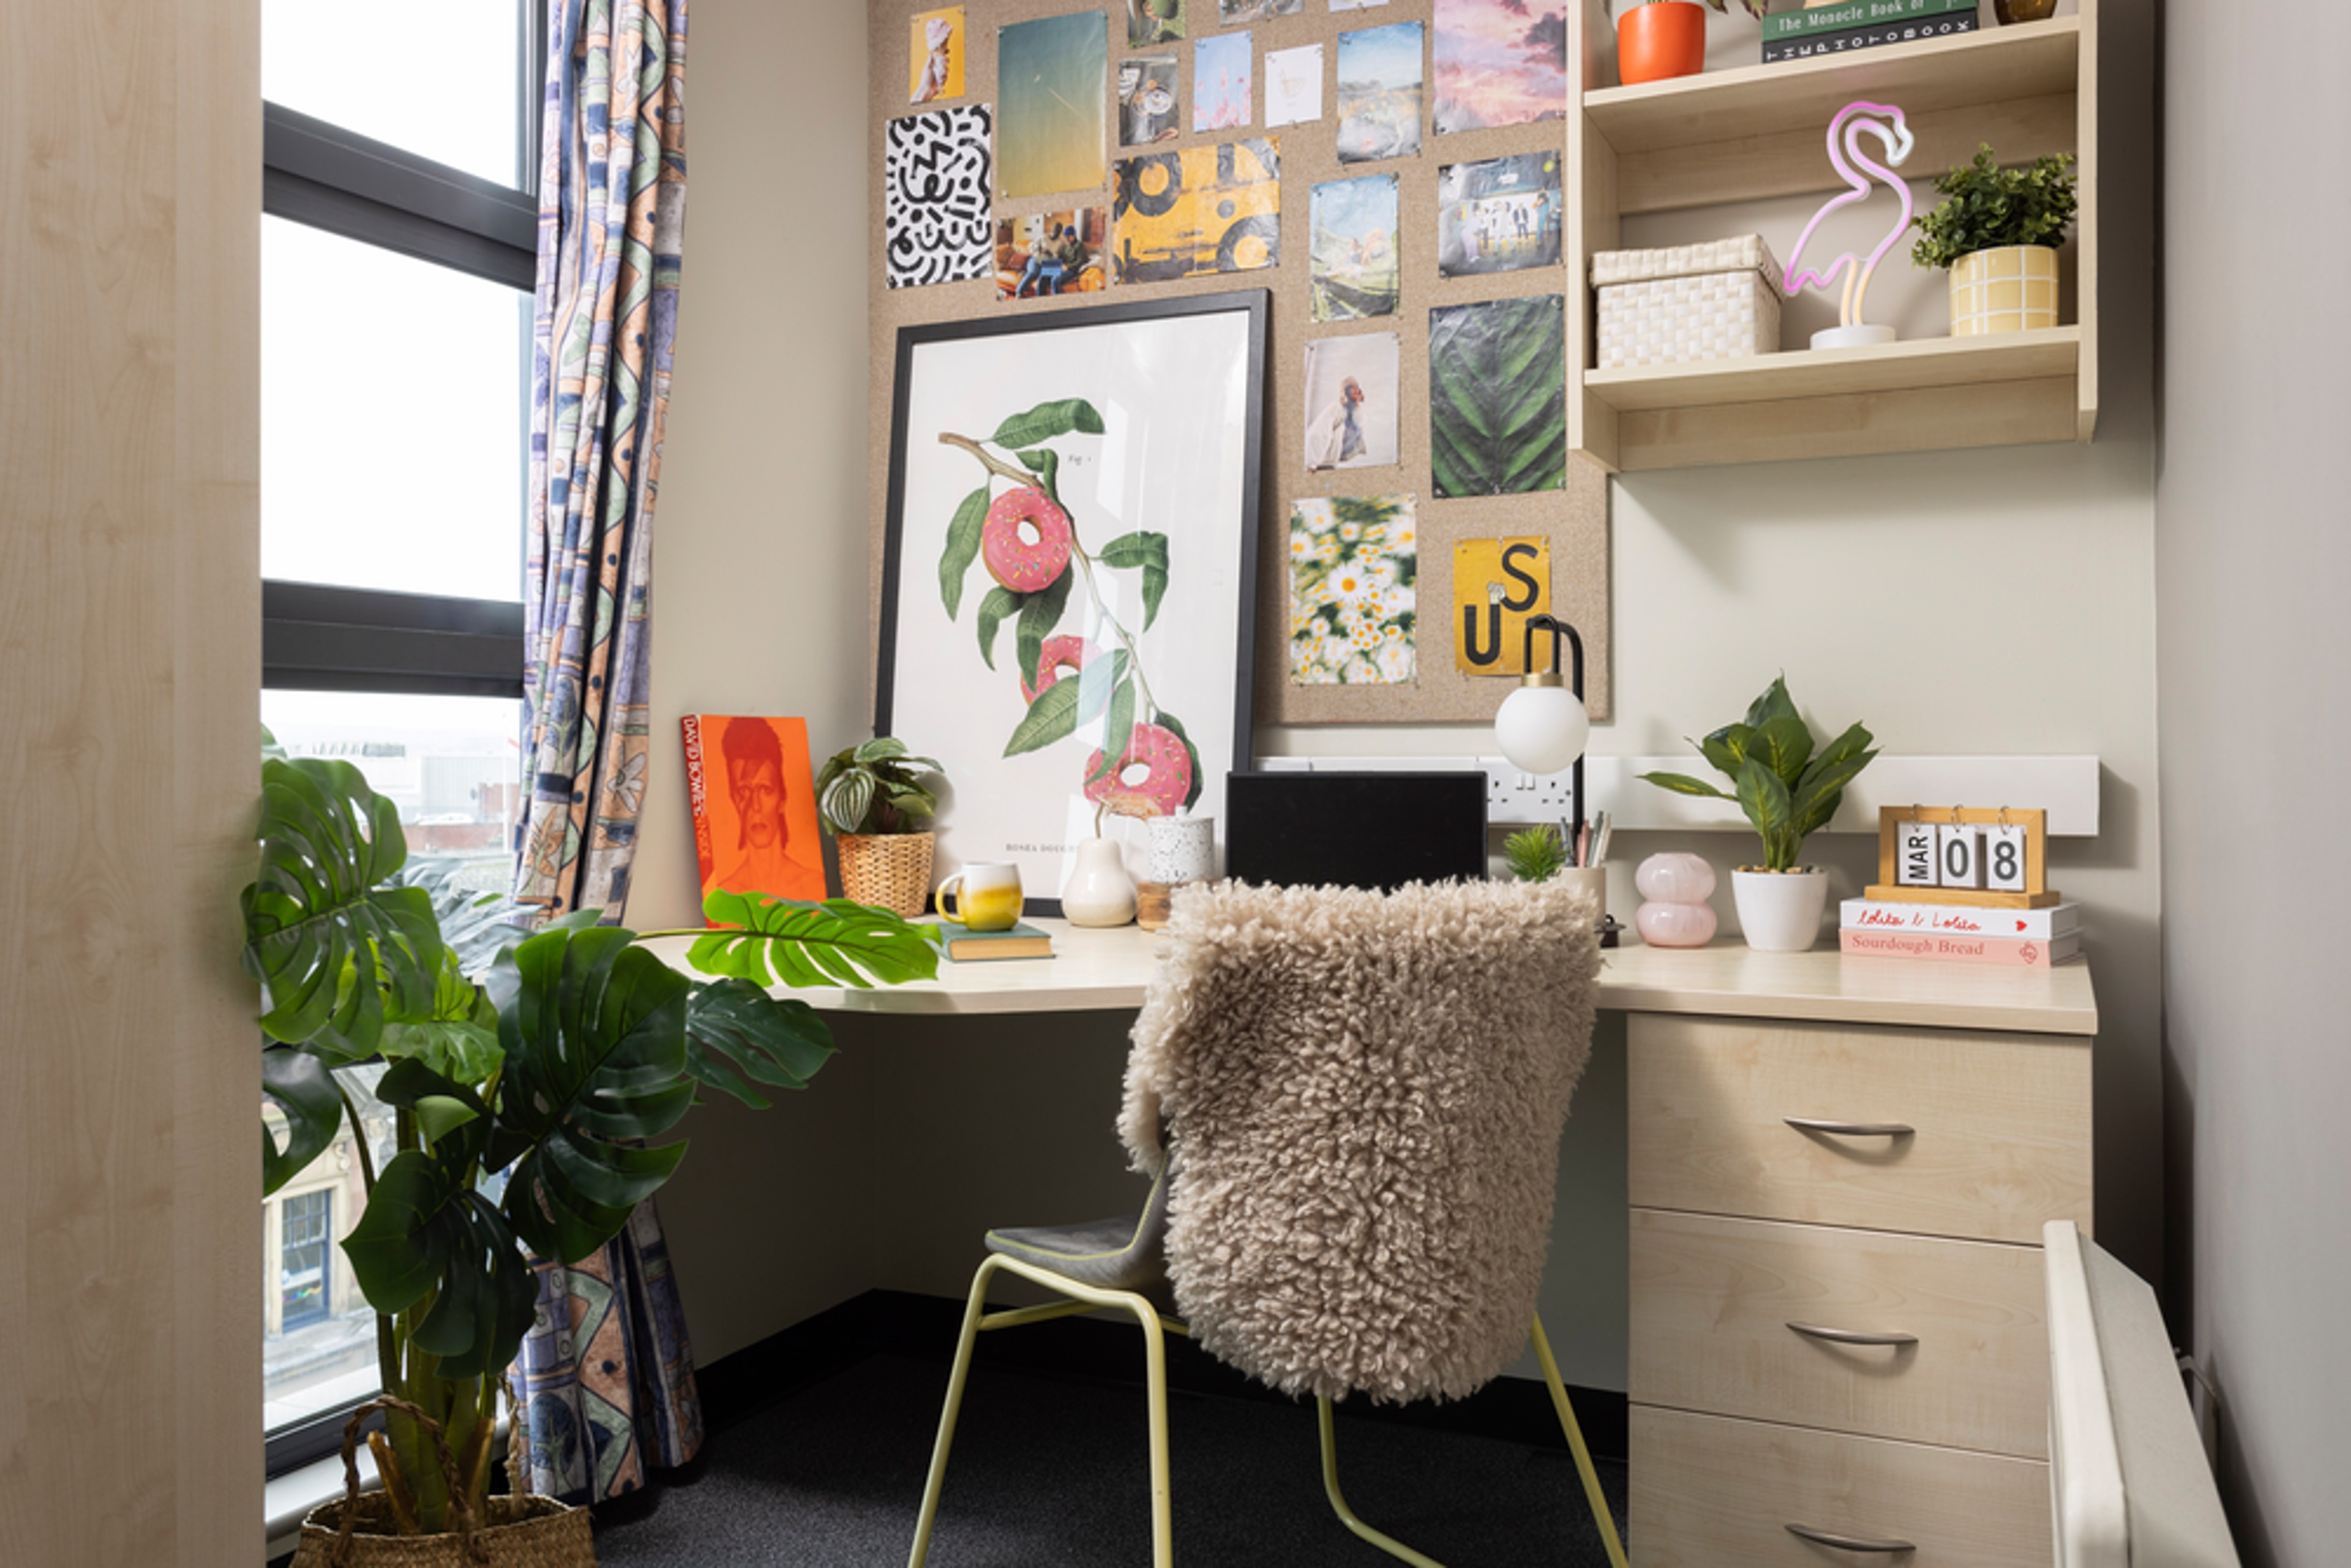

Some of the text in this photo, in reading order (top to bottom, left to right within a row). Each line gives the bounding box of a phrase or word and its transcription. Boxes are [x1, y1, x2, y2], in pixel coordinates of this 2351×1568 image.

[1779, 17, 1801, 31] The
[1809, 6, 1863, 26] Monocle
[1871, 0, 1902, 17] Book
[683, 718, 701, 760] DAVID
[688, 761, 705, 805] BOWIE
[1909, 836, 1928, 880] MAR
[1852, 934, 1984, 955] Sourdough Bread
